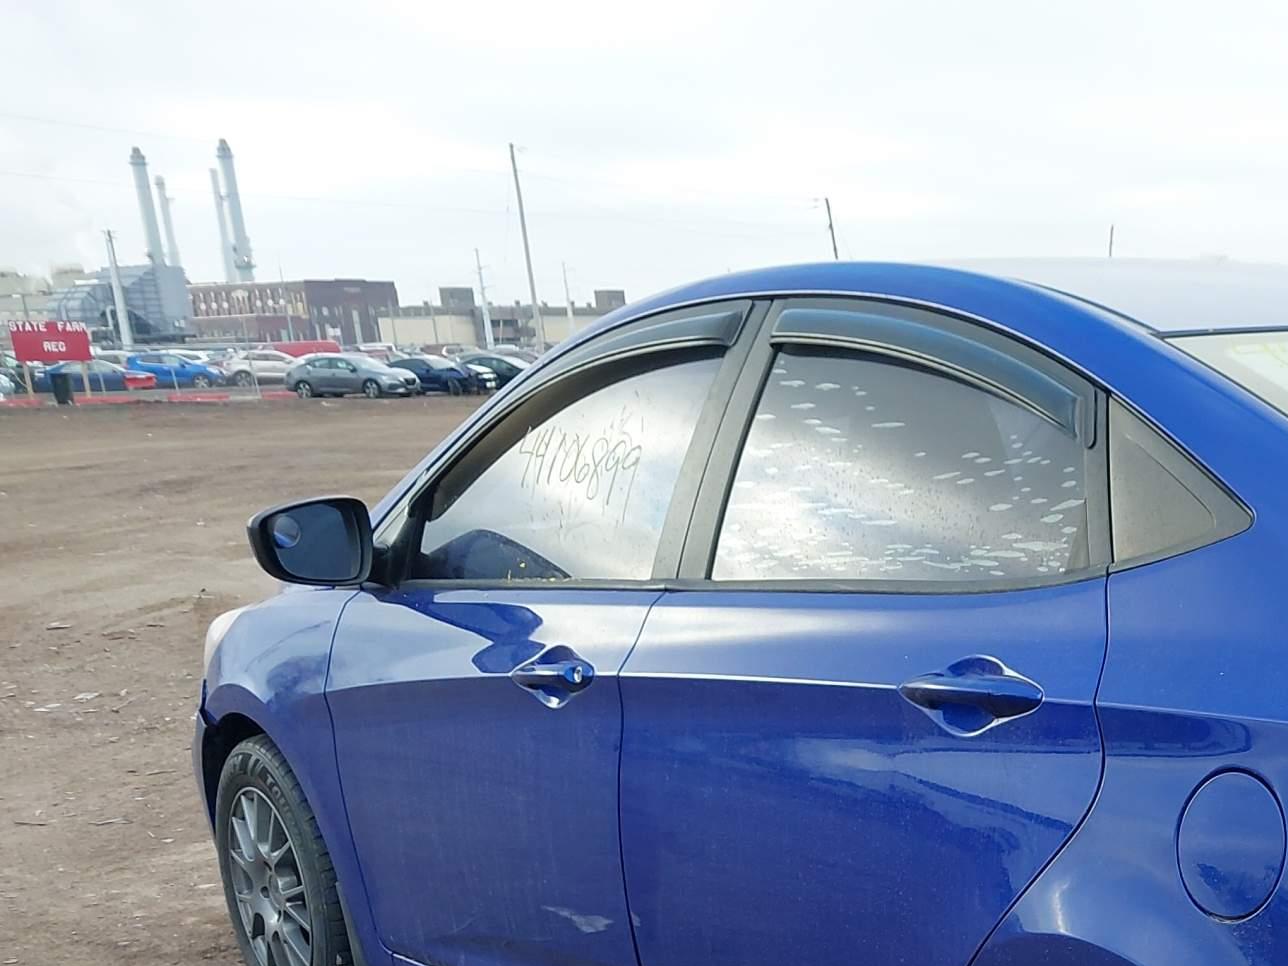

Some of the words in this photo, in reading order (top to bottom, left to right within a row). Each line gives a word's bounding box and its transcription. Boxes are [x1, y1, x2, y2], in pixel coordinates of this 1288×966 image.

[8, 320, 48, 332] STATE
[56, 320, 87, 332] FARM
[42, 341, 66, 352] RED
[519, 425, 643, 526] 44106899
